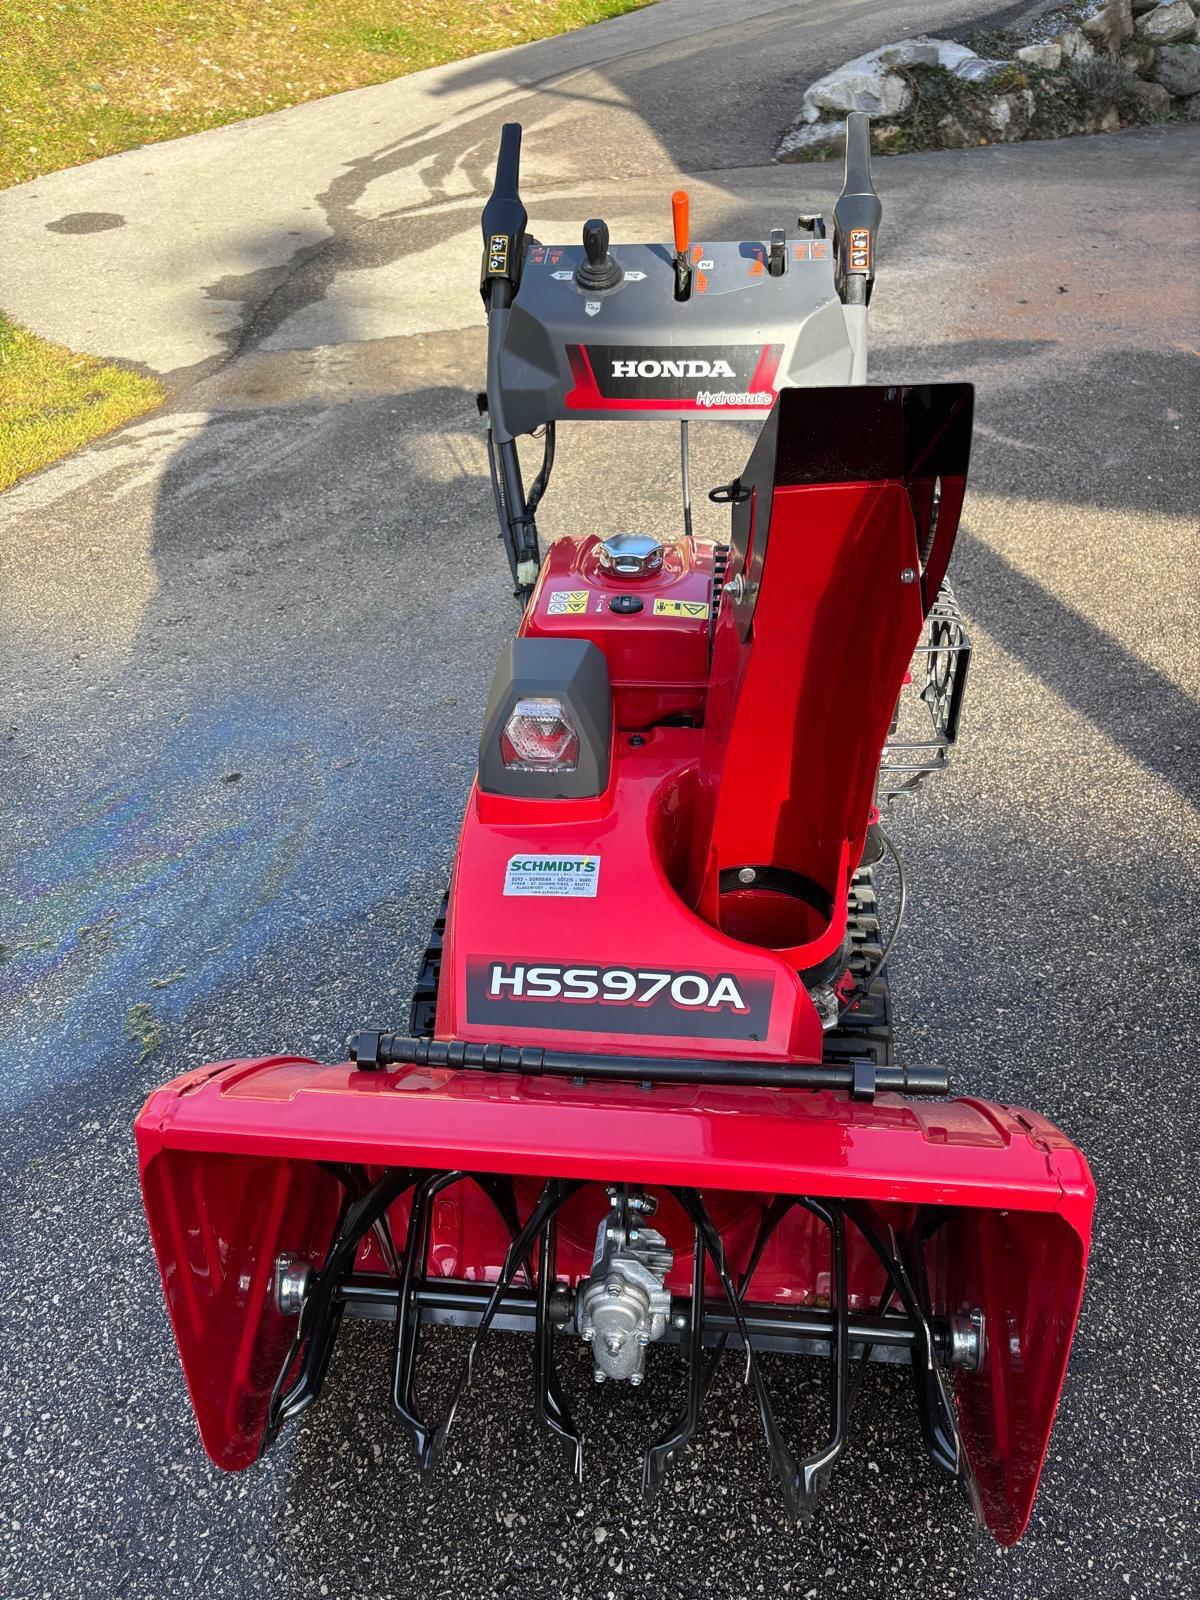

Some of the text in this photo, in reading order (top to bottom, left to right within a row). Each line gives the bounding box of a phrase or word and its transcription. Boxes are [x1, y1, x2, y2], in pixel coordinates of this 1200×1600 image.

[611, 360, 737, 378] HONDA
[696, 391, 773, 407] Hydrostatic
[489, 965, 746, 1009] HSS970A
